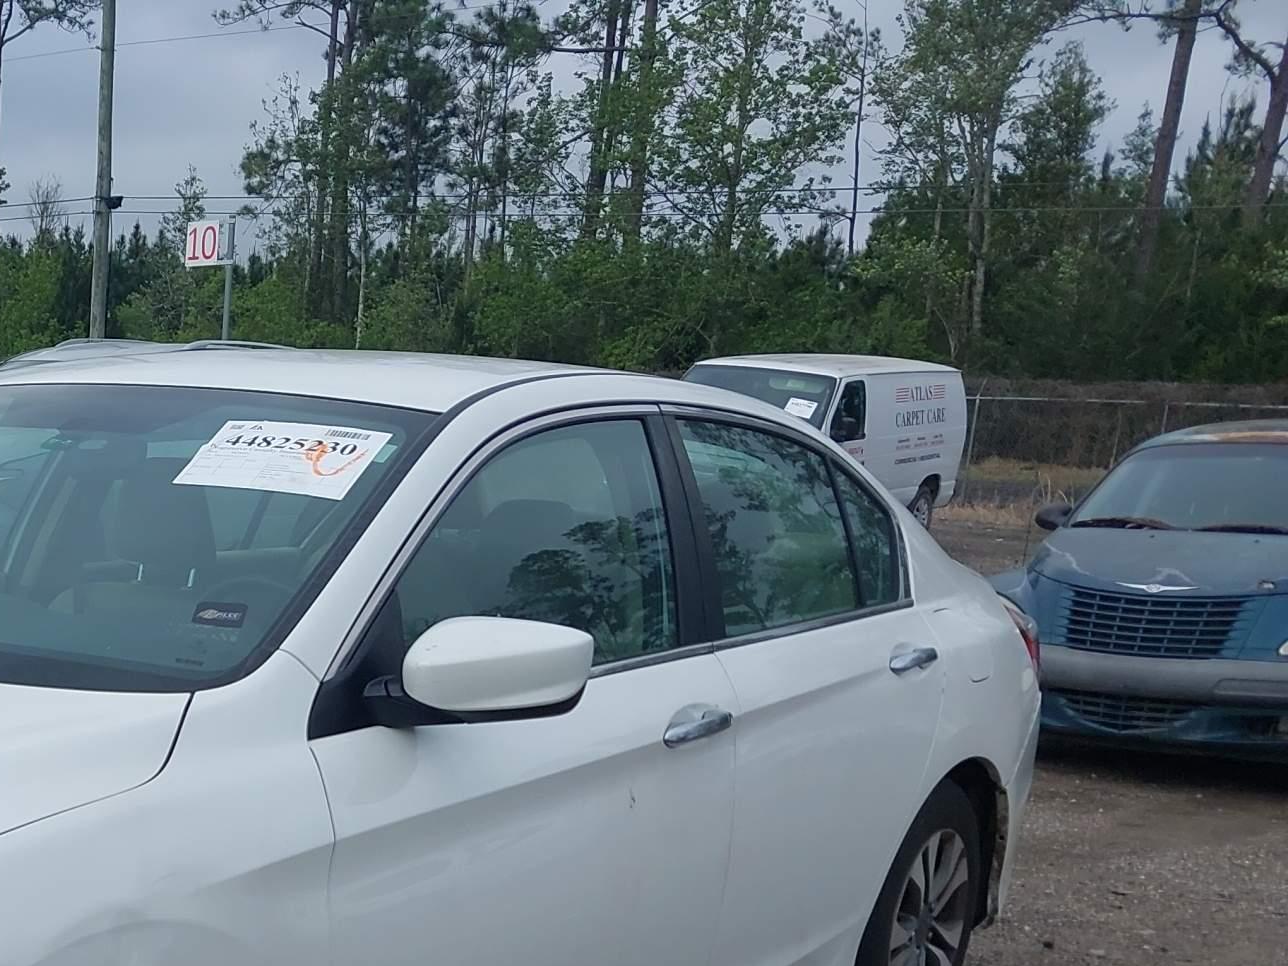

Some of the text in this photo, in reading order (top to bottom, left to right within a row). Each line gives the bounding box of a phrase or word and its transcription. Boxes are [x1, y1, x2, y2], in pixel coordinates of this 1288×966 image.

[187, 225, 217, 261] 10
[910, 385, 934, 402] ATLAS
[895, 407, 946, 428] CARPET CARE
[225, 433, 358, 456] 44825230
